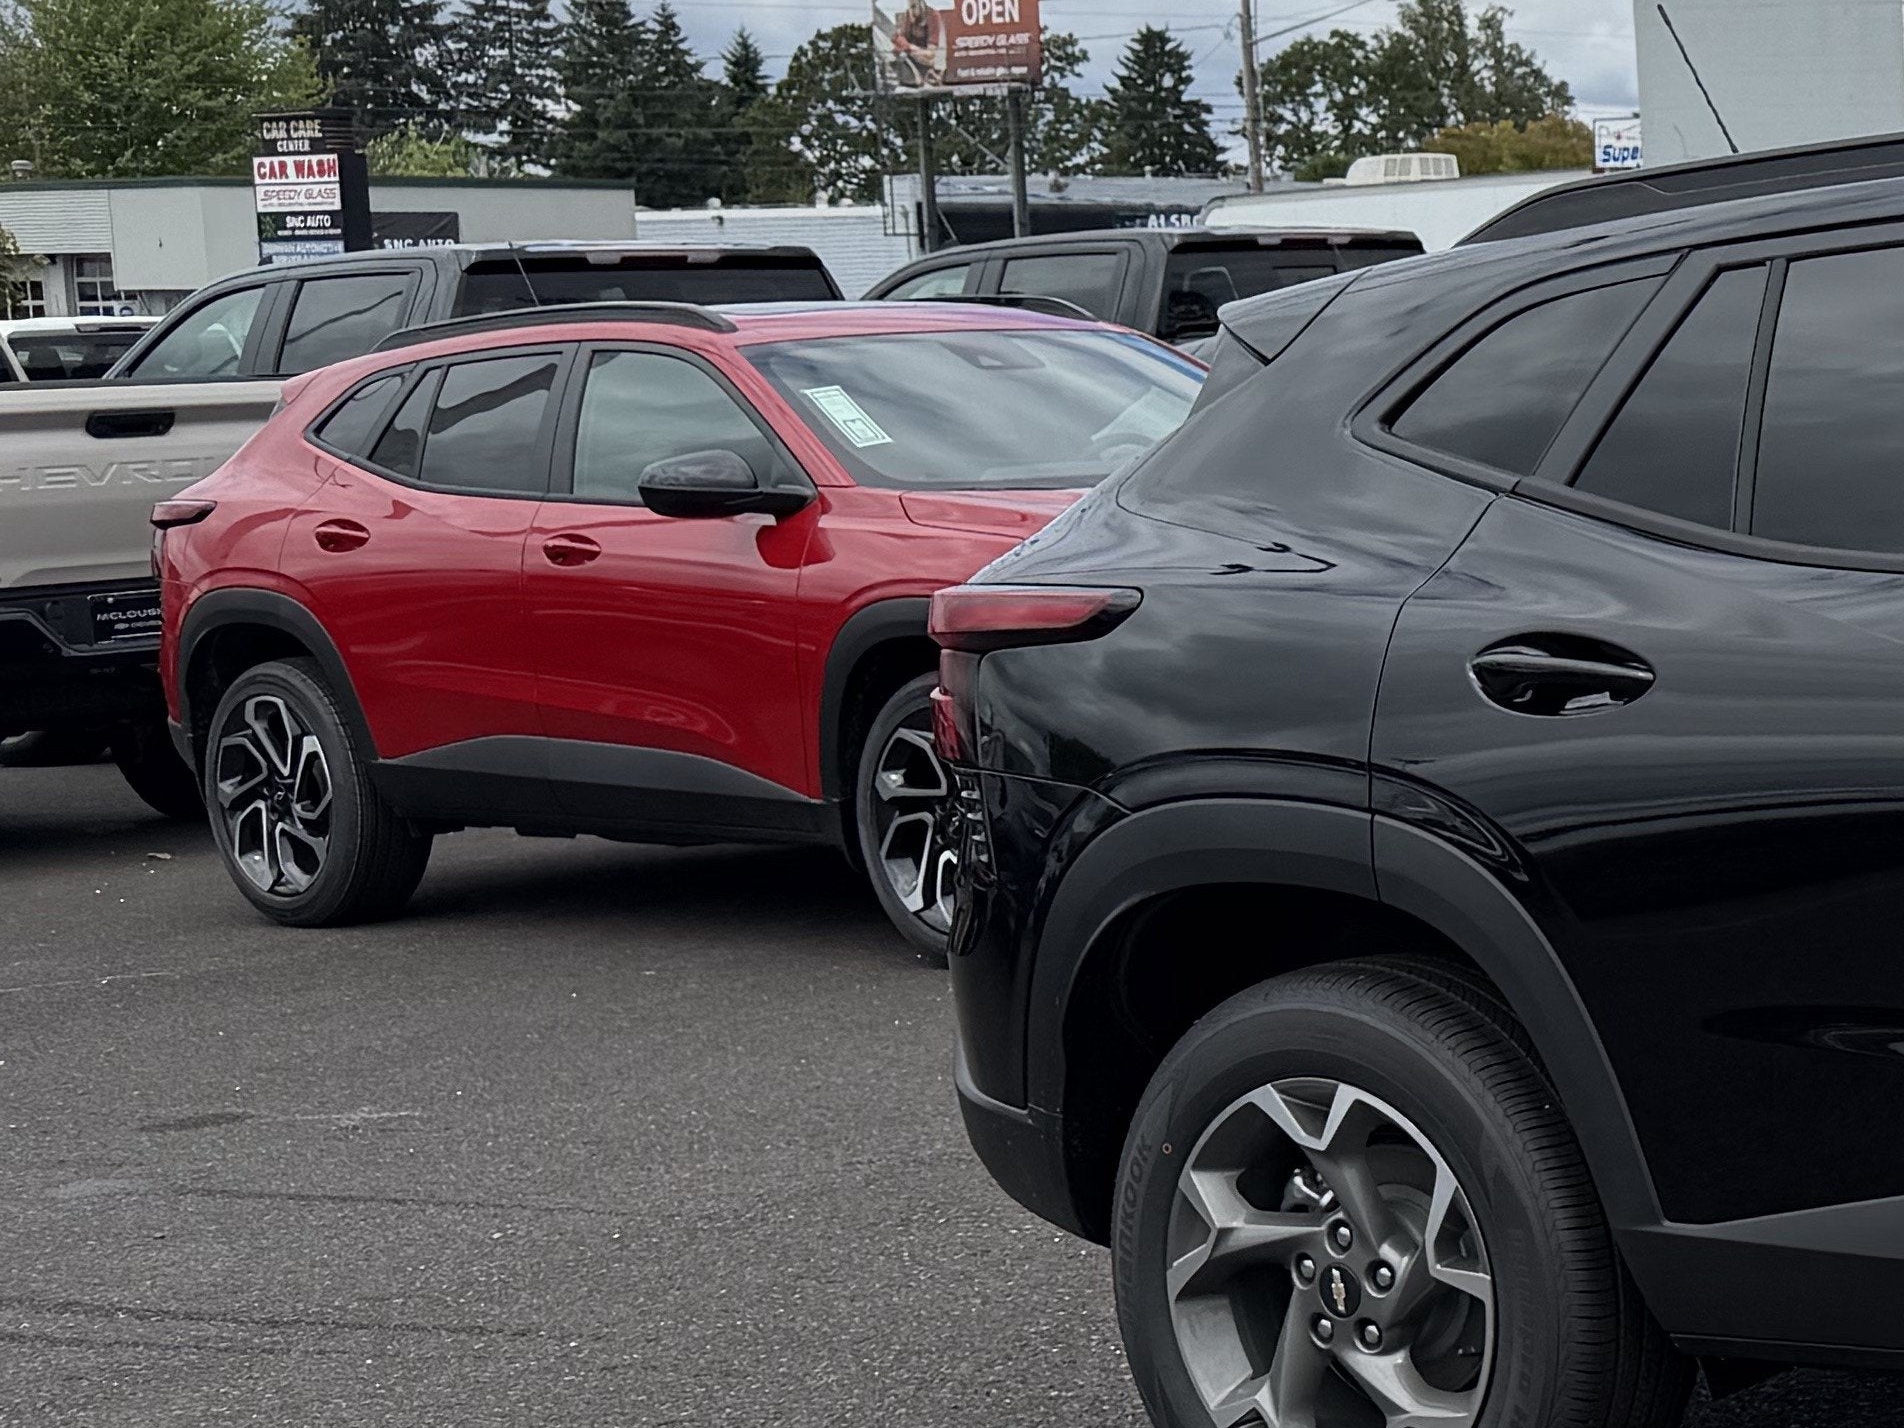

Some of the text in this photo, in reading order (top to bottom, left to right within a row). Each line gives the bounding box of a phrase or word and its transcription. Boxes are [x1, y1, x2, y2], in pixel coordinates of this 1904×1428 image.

[262, 119, 323, 140] CAR CARE
[276, 139, 311, 152] CENTER
[257, 158, 337, 180] CAR WASH
[261, 188, 337, 201] SPEEDY GLASS
[306, 214, 332, 227] AUTO
[418, 238, 455, 249] AUTO
